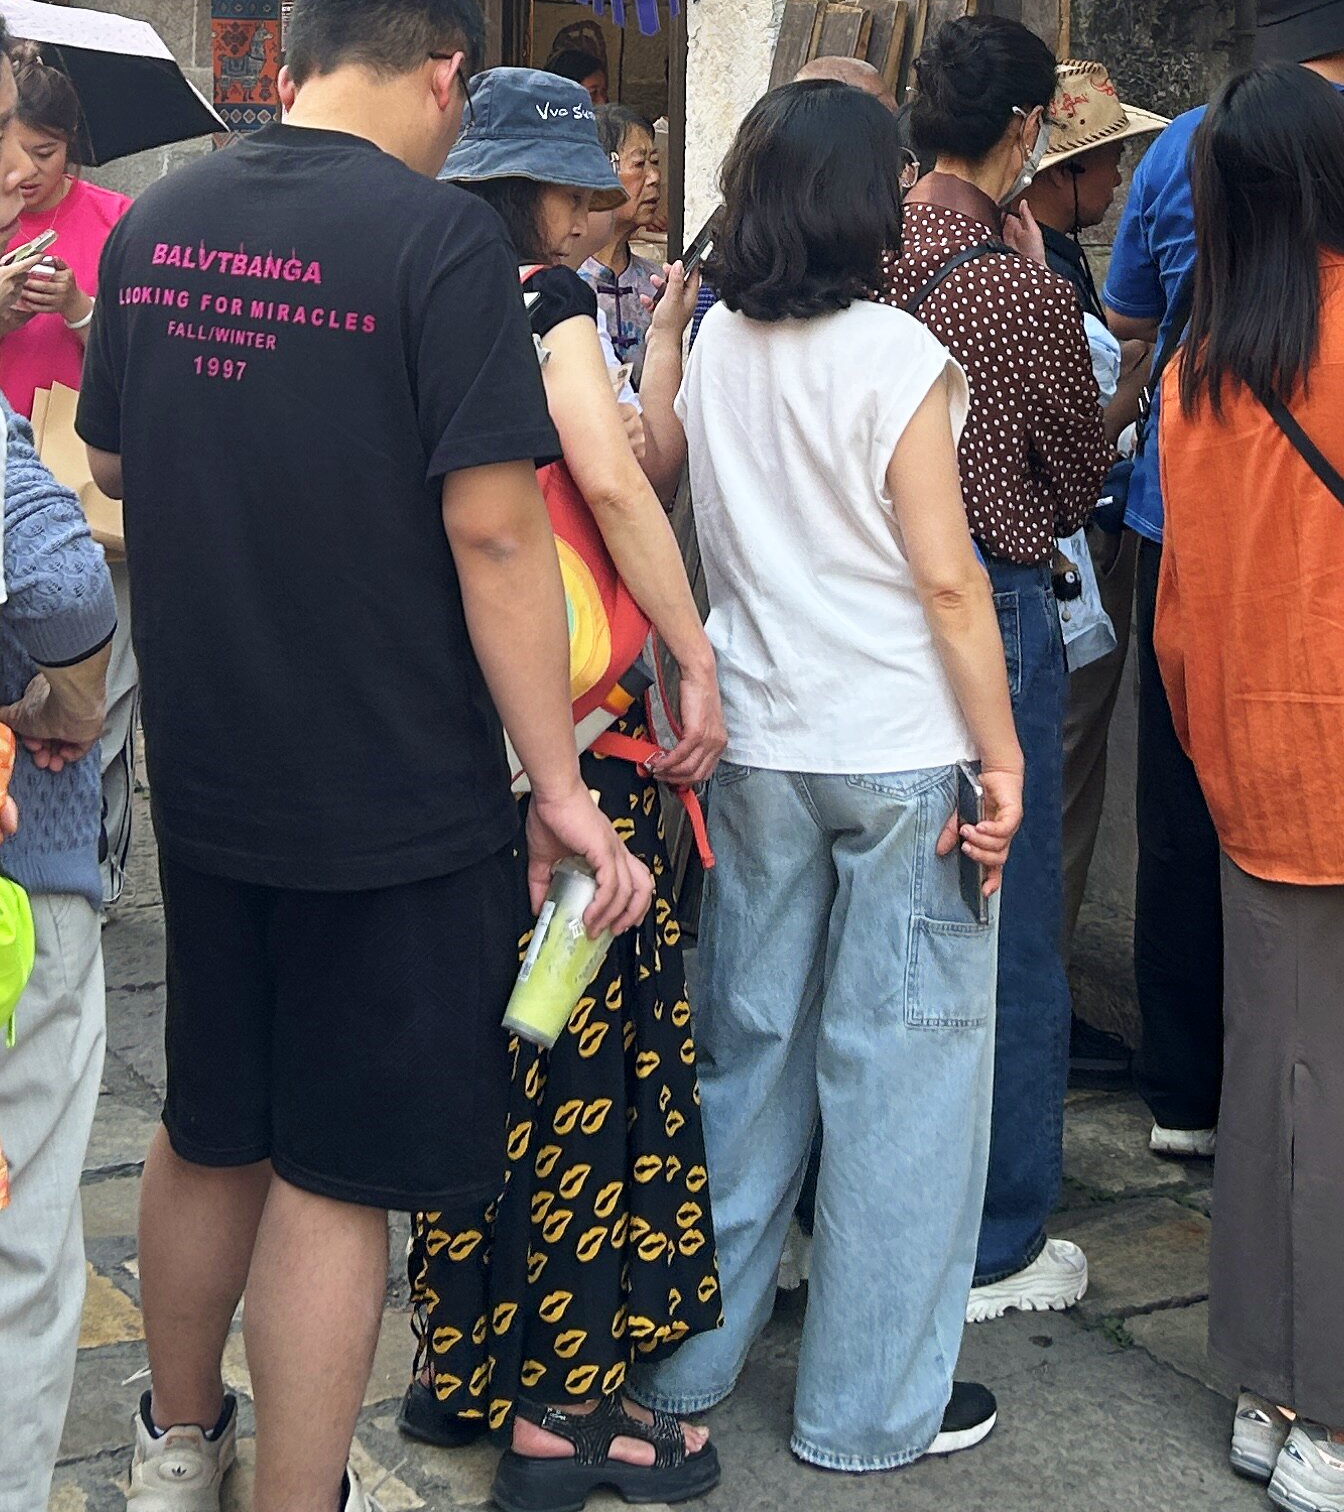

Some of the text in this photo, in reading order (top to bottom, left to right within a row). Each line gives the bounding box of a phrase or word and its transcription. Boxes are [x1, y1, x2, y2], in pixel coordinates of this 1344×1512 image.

[119, 286, 377, 334] LOOKING FOR MIRACLES
[167, 321, 277, 351] FALL/WINTER
[193, 356, 248, 381] 1997
